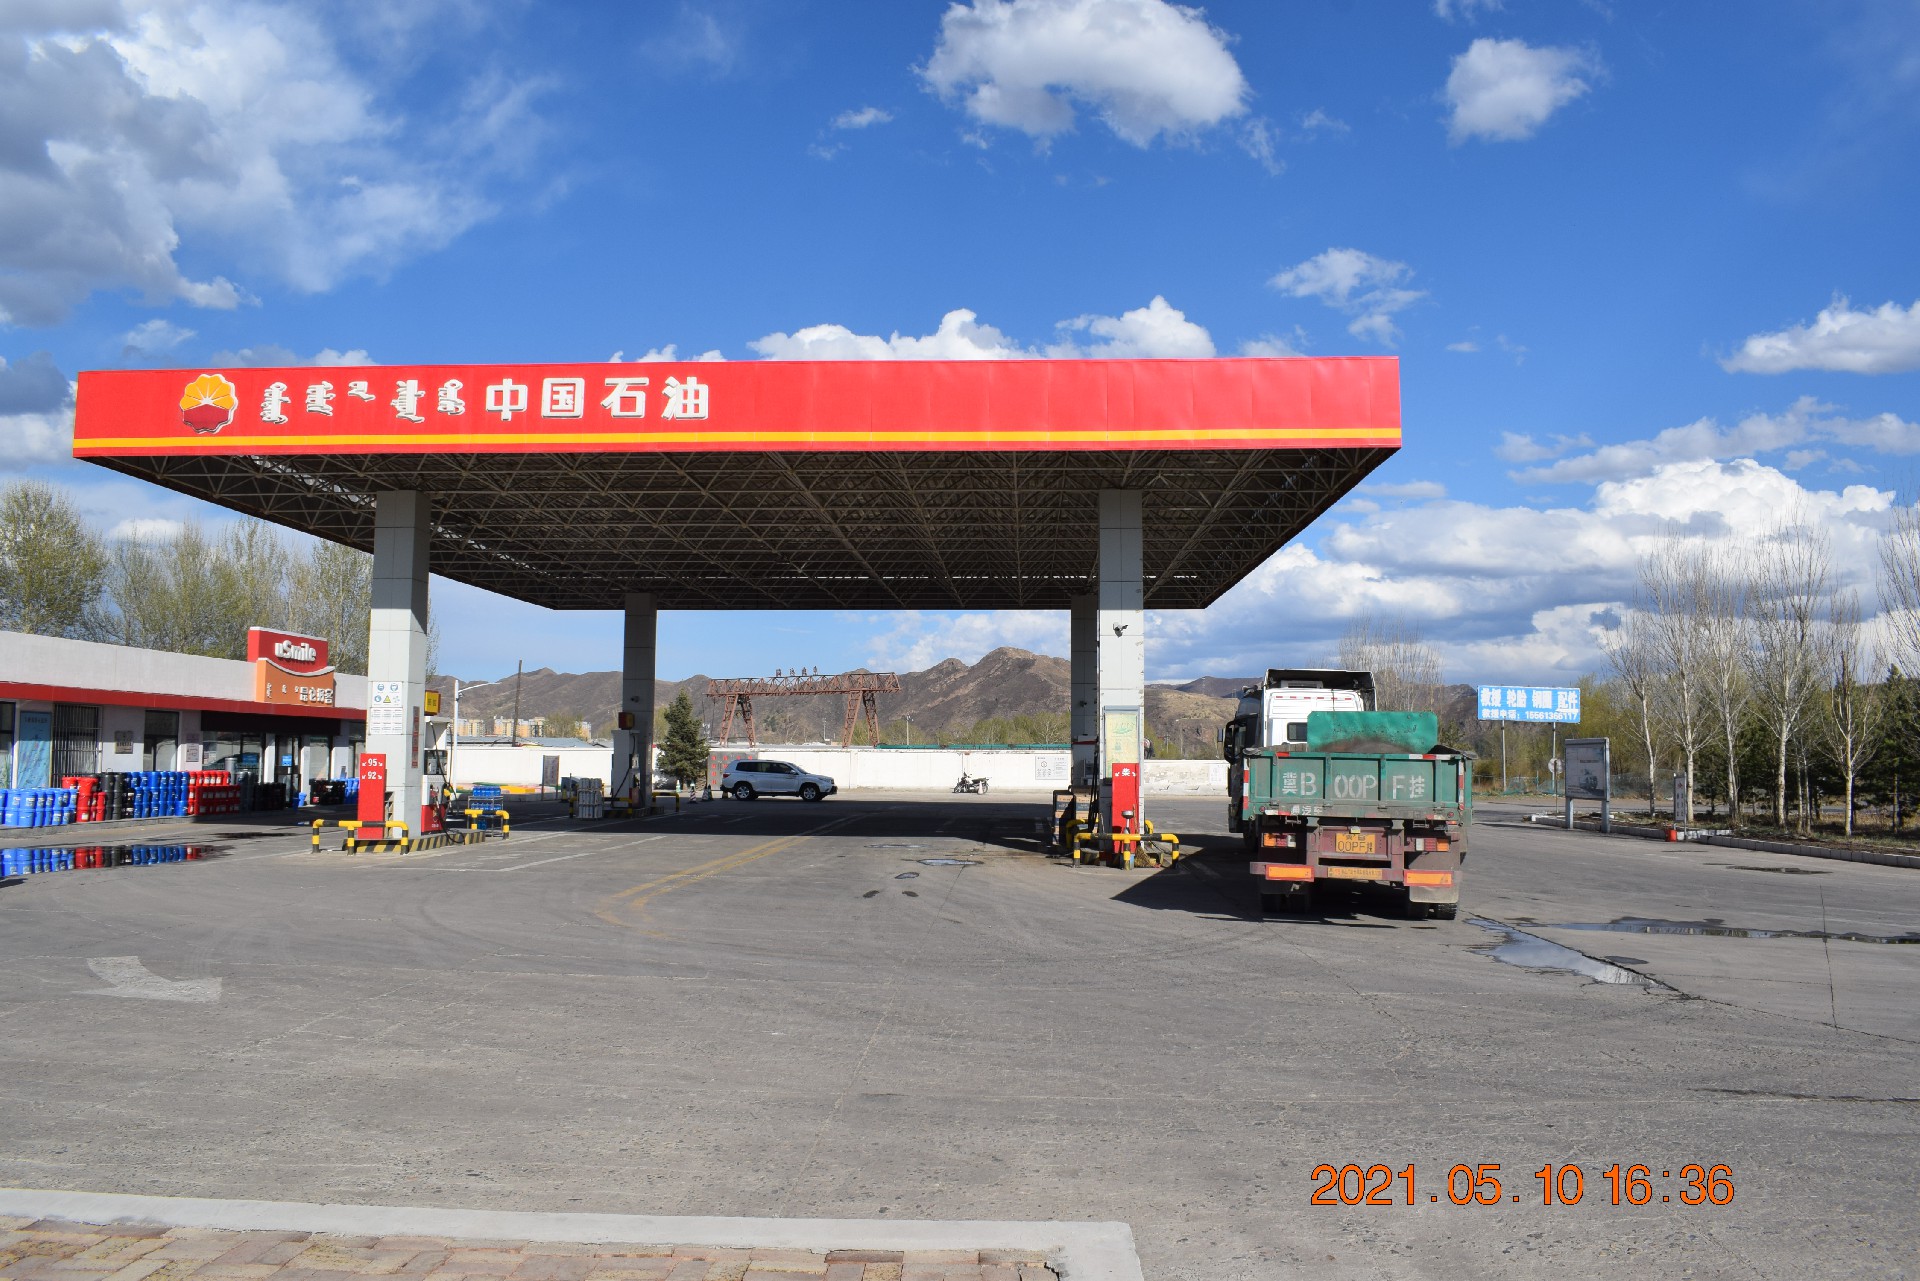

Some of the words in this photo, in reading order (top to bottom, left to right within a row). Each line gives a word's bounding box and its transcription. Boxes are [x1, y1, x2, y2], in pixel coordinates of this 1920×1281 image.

[485, 375, 709, 421] 中国石油
[274, 640, 317, 662] uSmile
[368, 758, 378, 767] 95
[367, 771, 377, 780] 92
